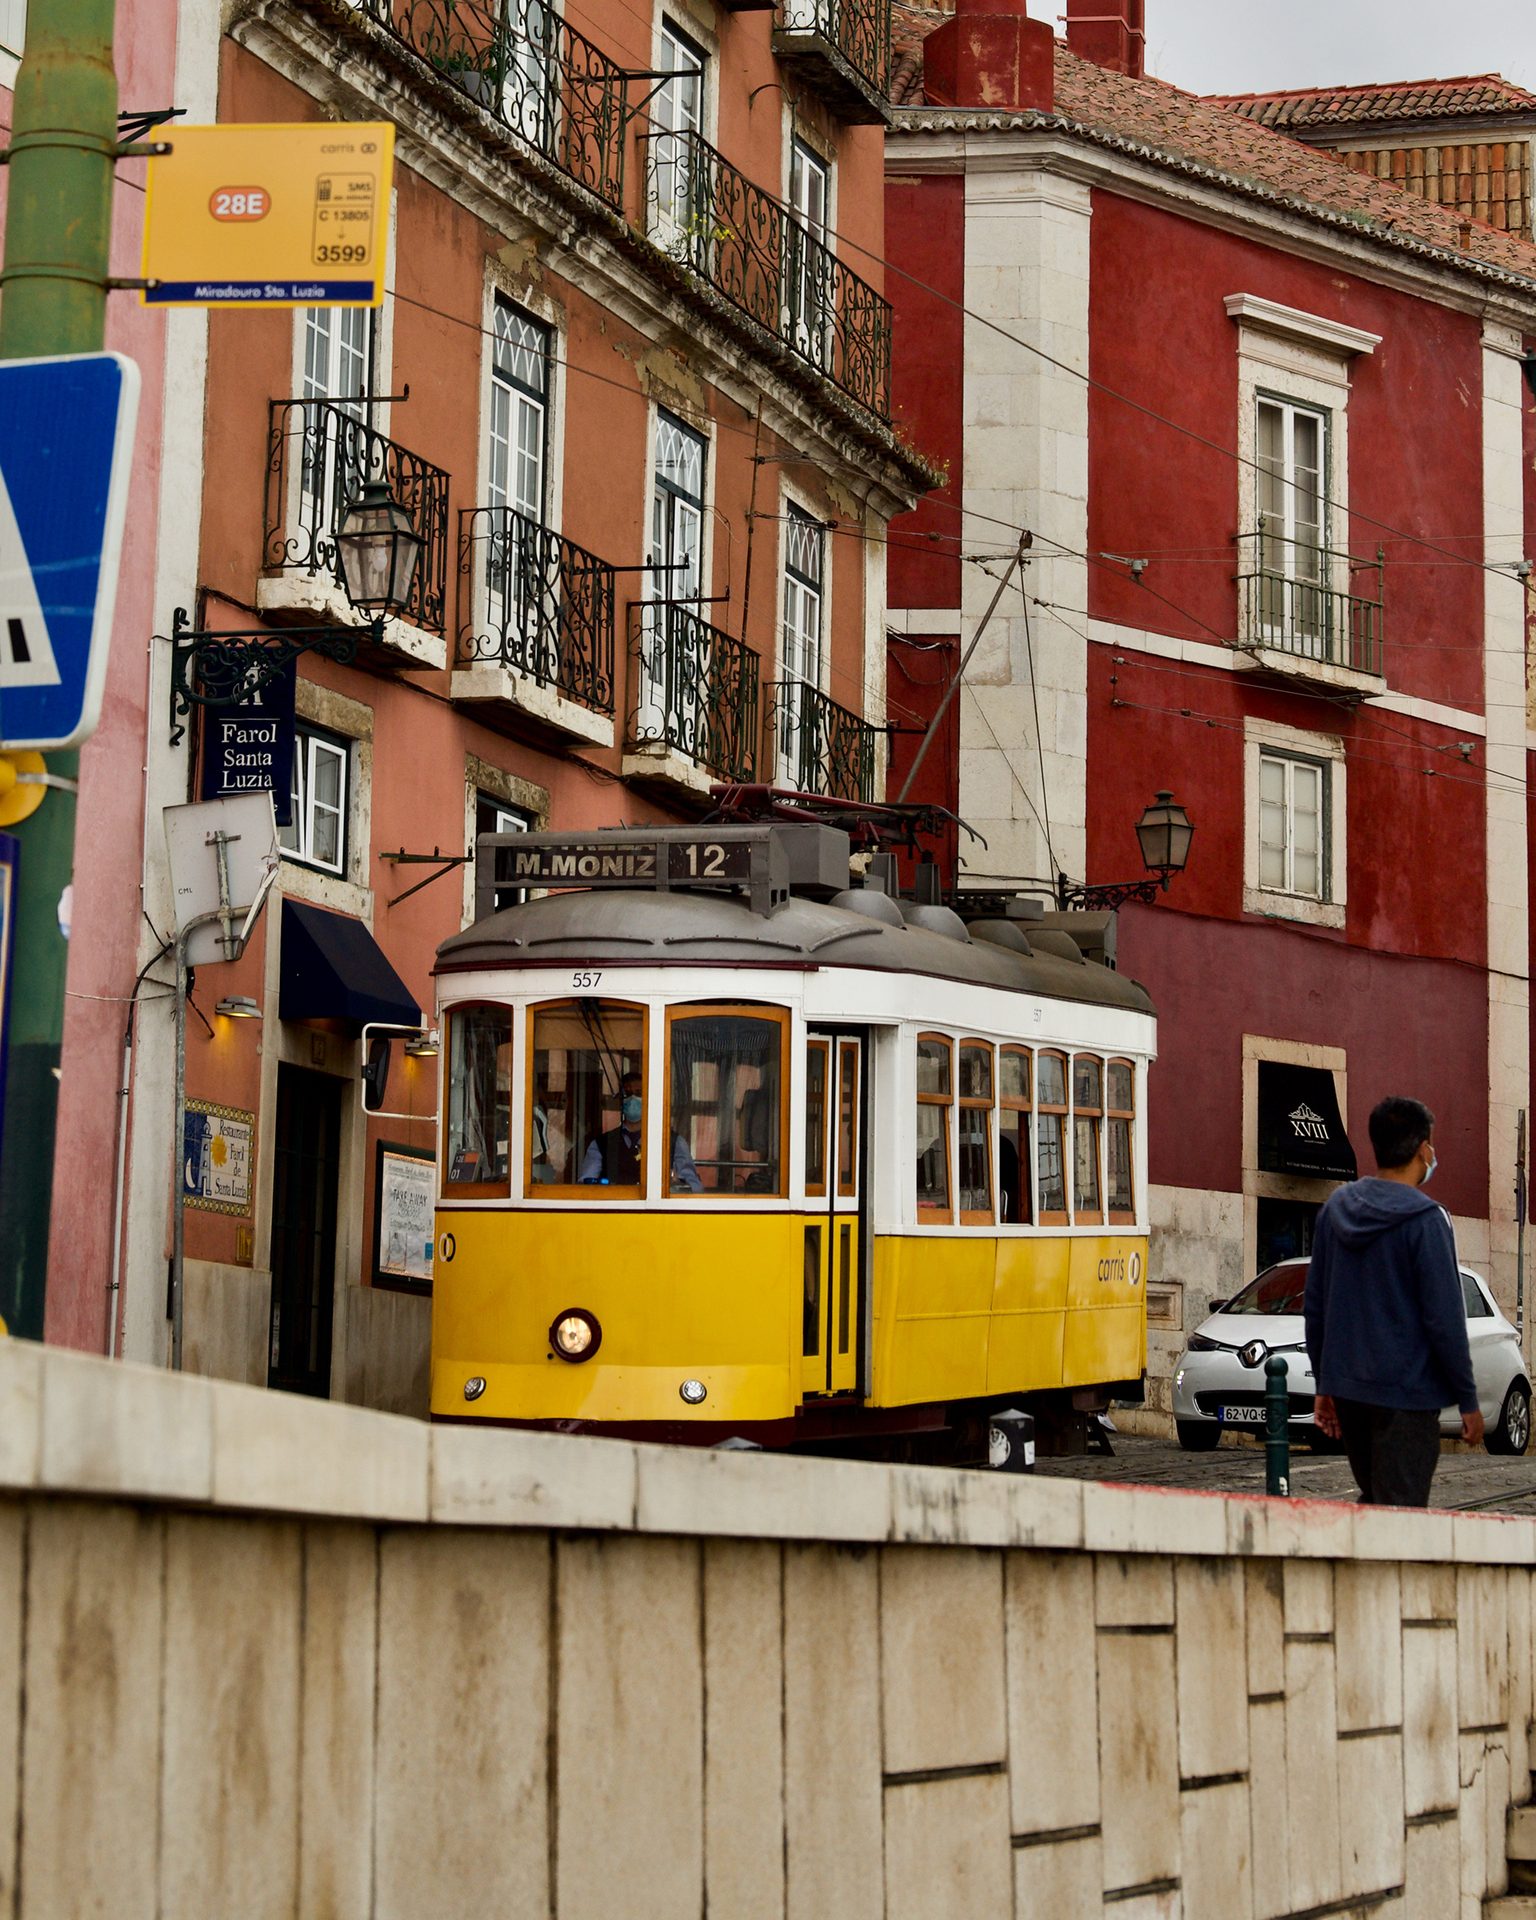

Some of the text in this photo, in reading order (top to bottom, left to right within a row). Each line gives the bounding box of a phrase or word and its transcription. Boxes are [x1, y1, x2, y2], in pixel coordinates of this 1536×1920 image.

[320, 142, 355, 154] carris
[215, 193, 265, 215] 28E
[319, 210, 329, 222] C
[317, 244, 367, 262] 3599
[194, 284, 326, 298] Miradouro Sta. Luzia
[221, 723, 277, 743] Farol
[223, 749, 273, 767] Santa
[222, 770, 273, 788] Luzia
[515, 853, 656, 877] M.MONIZ
[685, 844, 726, 877] 12
[572, 972, 602, 988] 557
[219, 1119, 250, 1140] Restaurante
[1290, 1120, 1330, 1140] XVIII
[230, 1143, 244, 1161] Farol
[233, 1161, 241, 1177] de
[215, 1177, 247, 1198] Santa Luzia
[1098, 1249, 1124, 1281] carris
